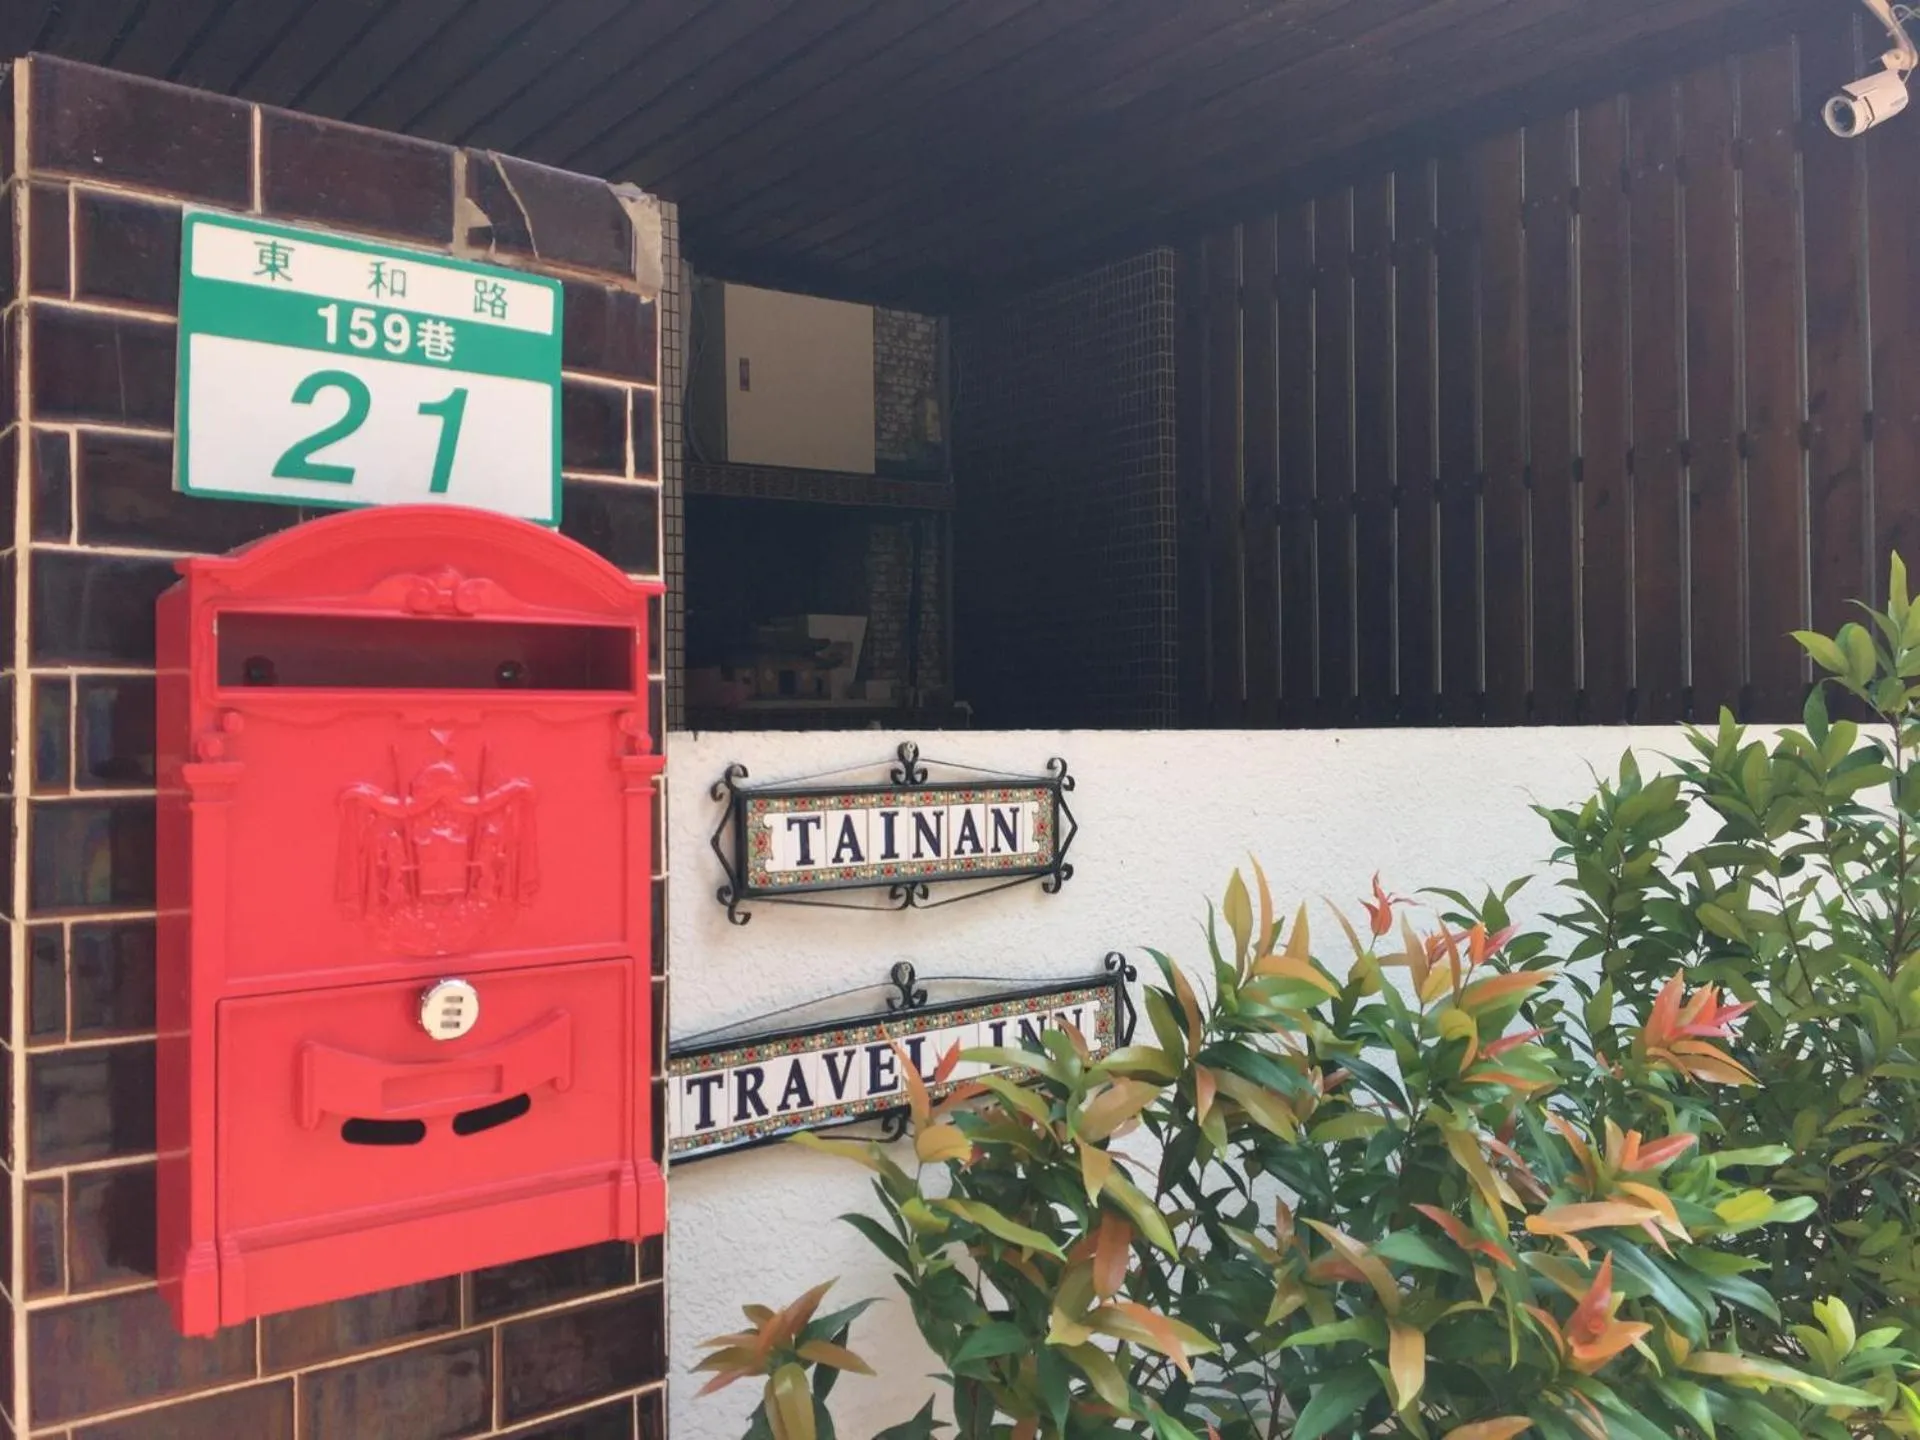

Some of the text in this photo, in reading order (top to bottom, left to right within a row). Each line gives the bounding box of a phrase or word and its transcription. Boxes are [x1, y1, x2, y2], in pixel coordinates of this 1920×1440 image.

[253, 240, 509, 320] 東和路
[317, 303, 456, 362] 159巷
[271, 369, 469, 493] 21
[787, 807, 1020, 866] TAINAN
[686, 1036, 937, 1130] TRAVEL
